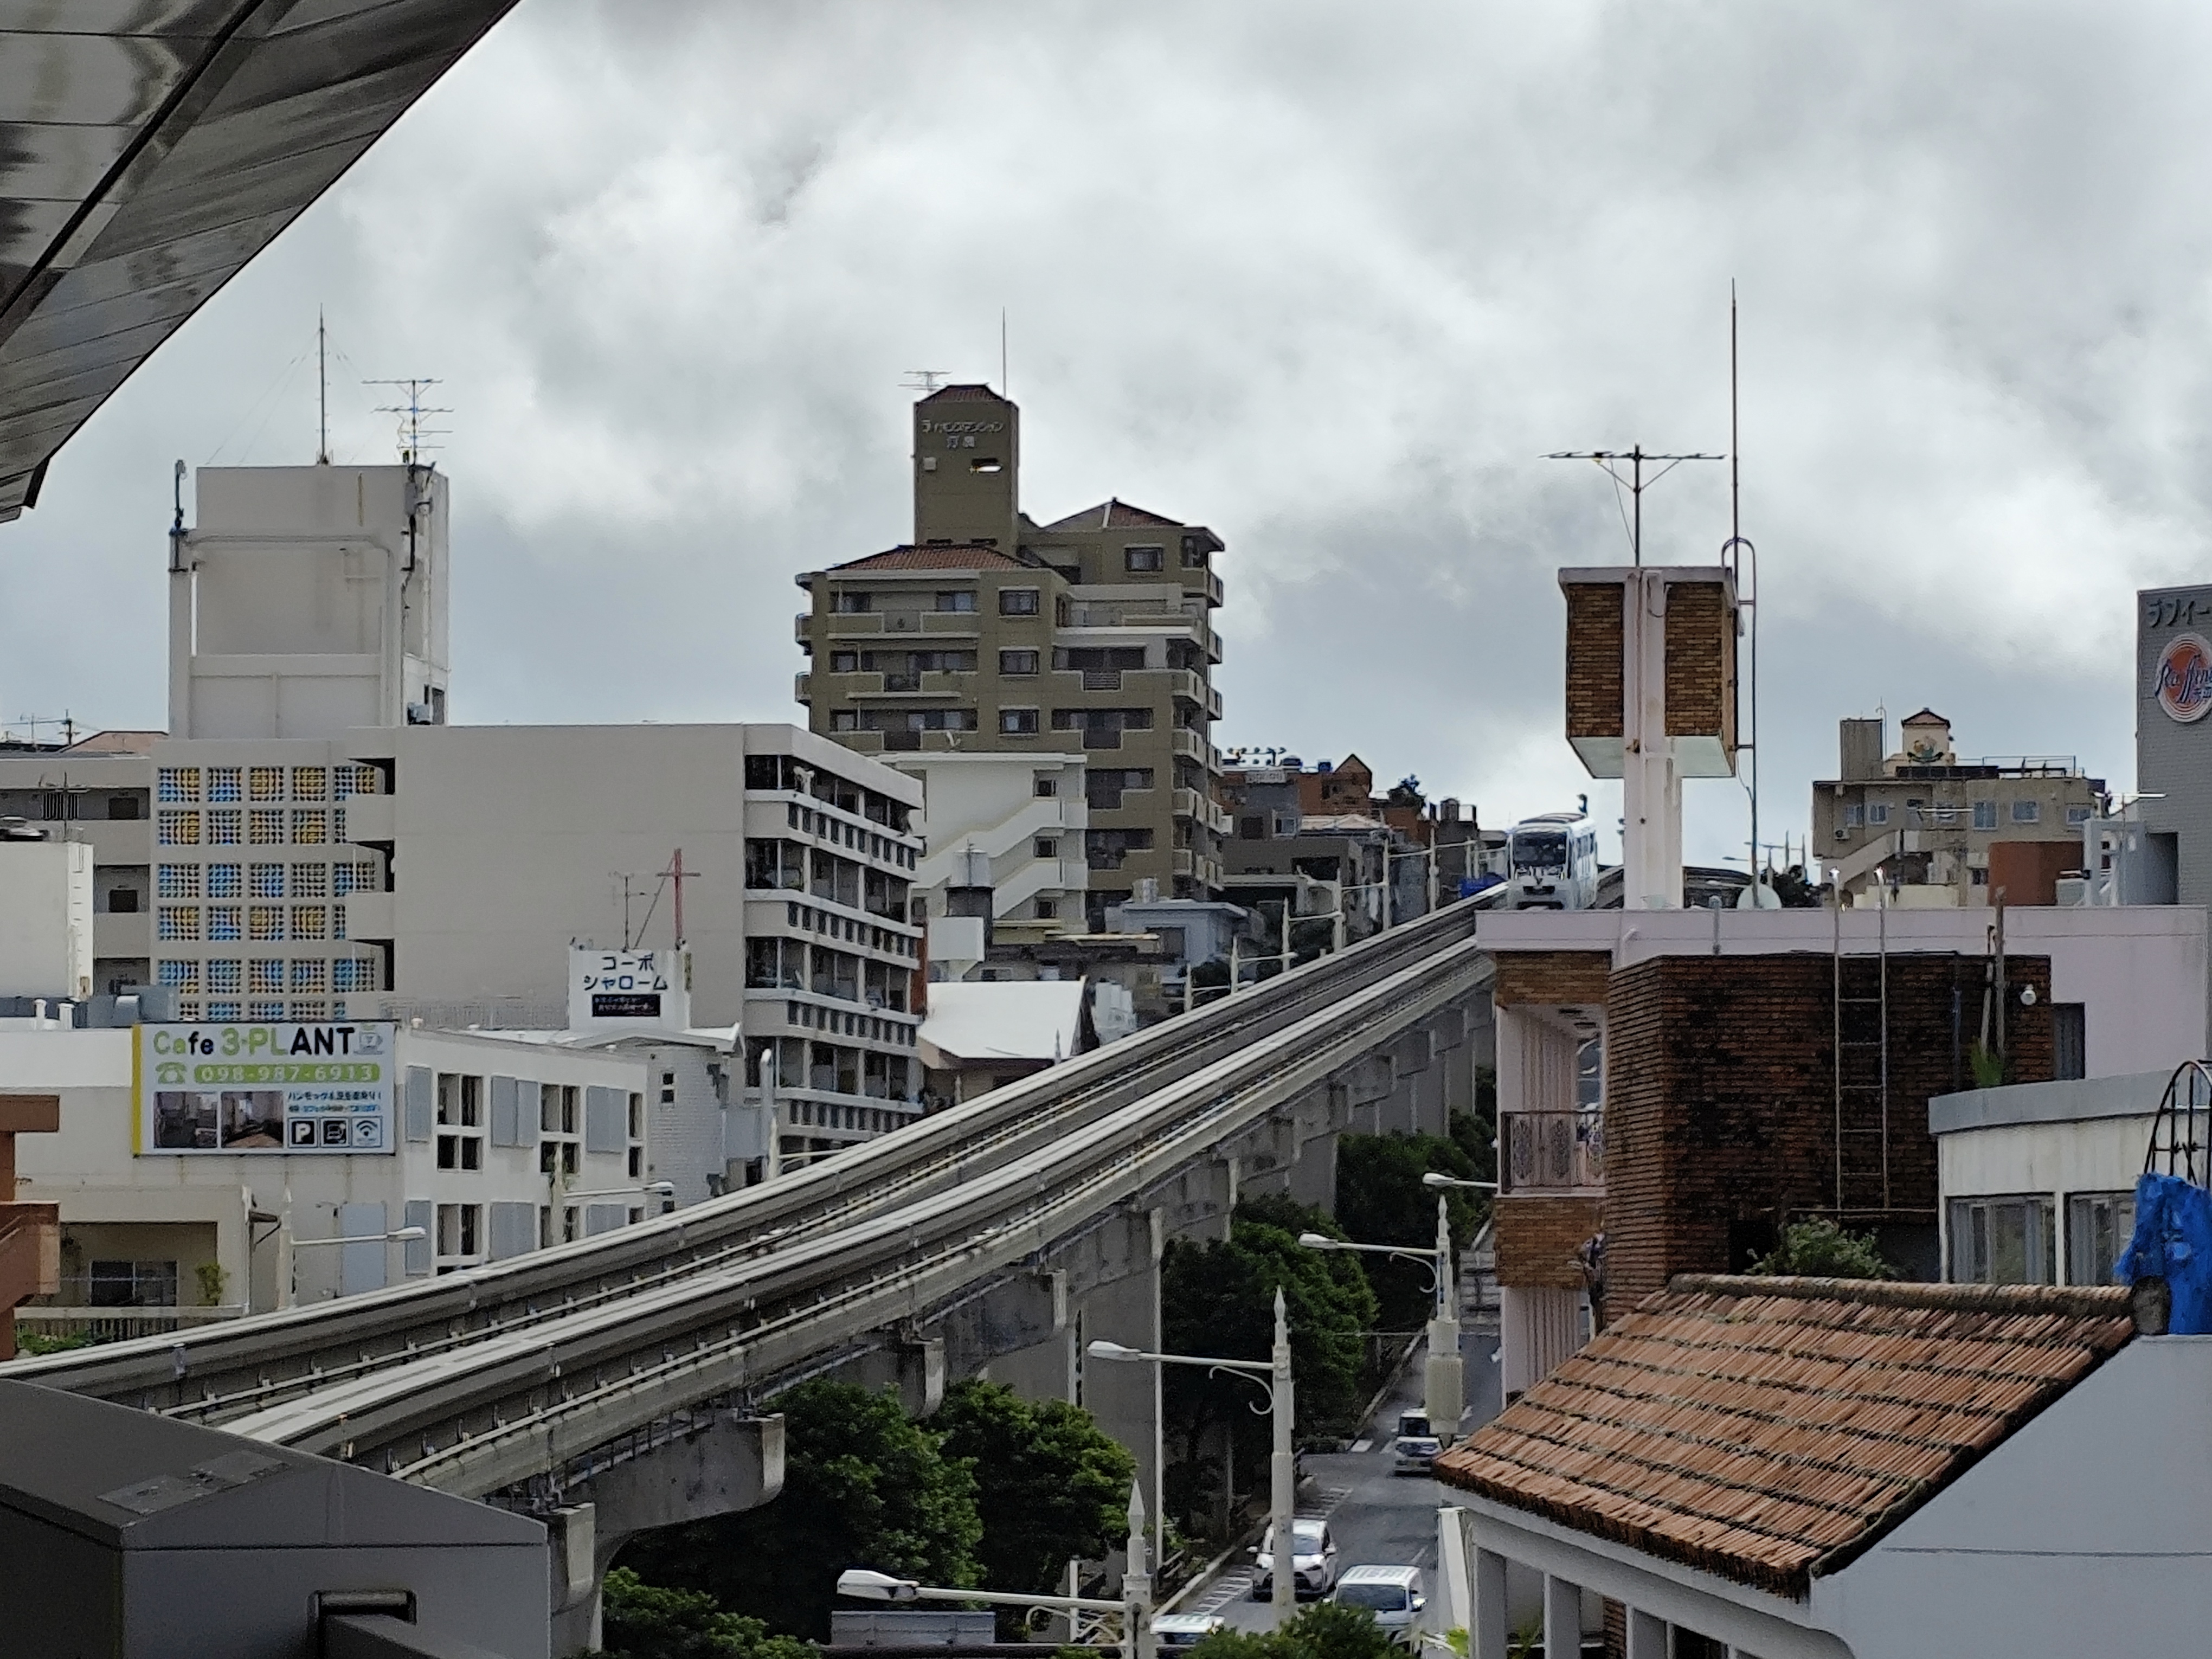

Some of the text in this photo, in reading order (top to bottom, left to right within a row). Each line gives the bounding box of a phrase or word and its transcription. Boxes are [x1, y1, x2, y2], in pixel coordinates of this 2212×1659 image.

[583, 975, 668, 991] シャローム
[153, 1030, 214, 1056] Cafe
[201, 1066, 373, 1082] 098-987-6913
[295, 1124, 311, 1143] P
